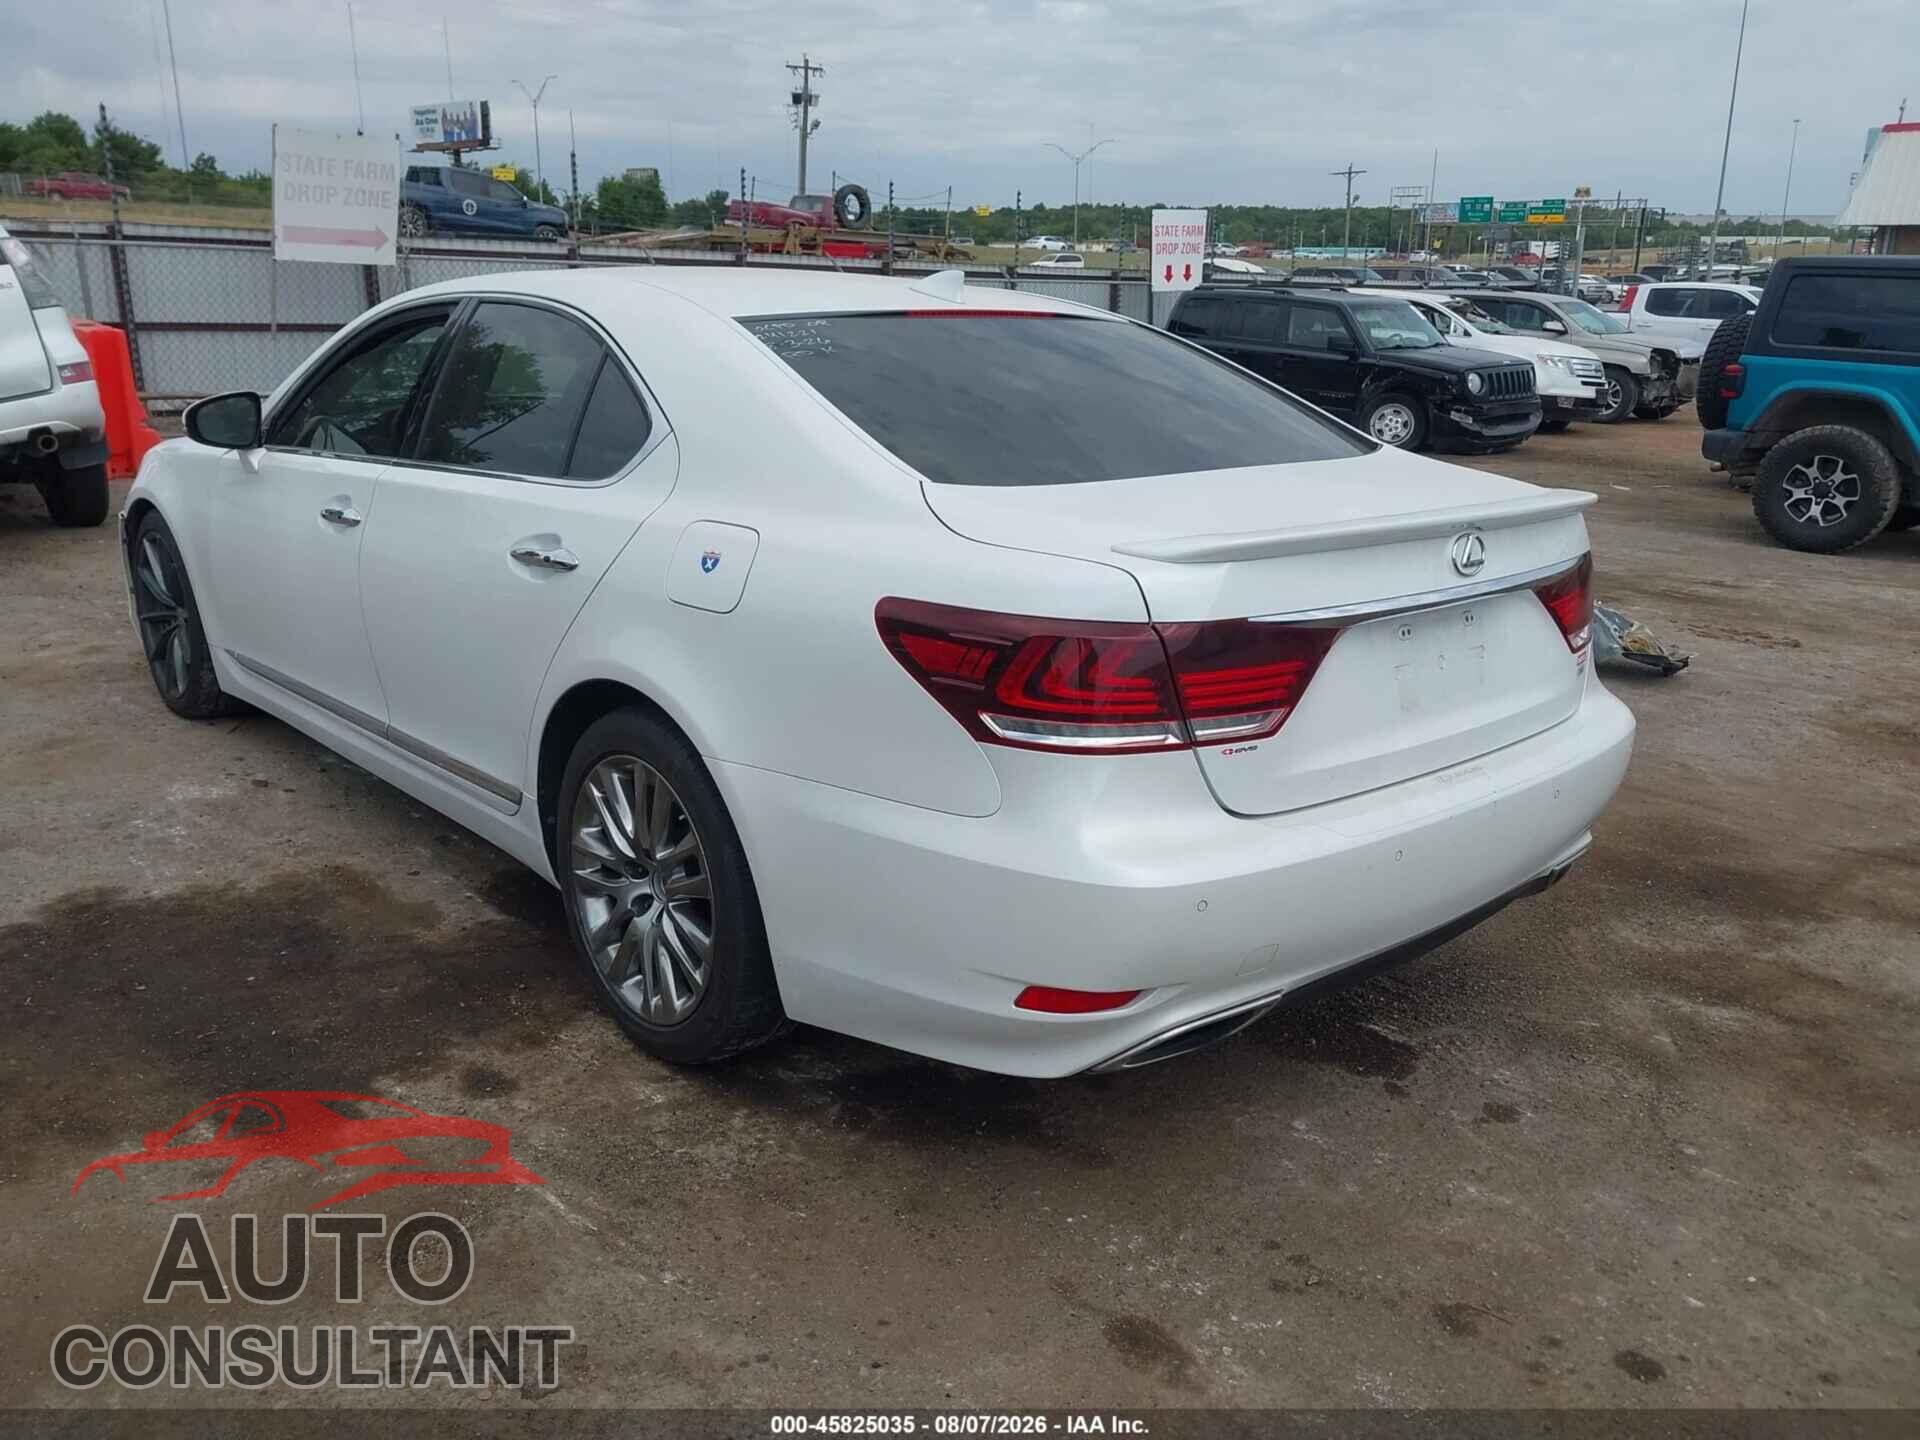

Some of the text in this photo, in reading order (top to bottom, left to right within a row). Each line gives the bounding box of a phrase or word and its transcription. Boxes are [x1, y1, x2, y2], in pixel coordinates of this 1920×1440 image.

[280, 152, 395, 182] STATE FARM
[284, 182, 392, 208] DROP ZONE
[1154, 225, 1203, 237] STATE FARM
[1156, 243, 1200, 254] DROP ZONE
